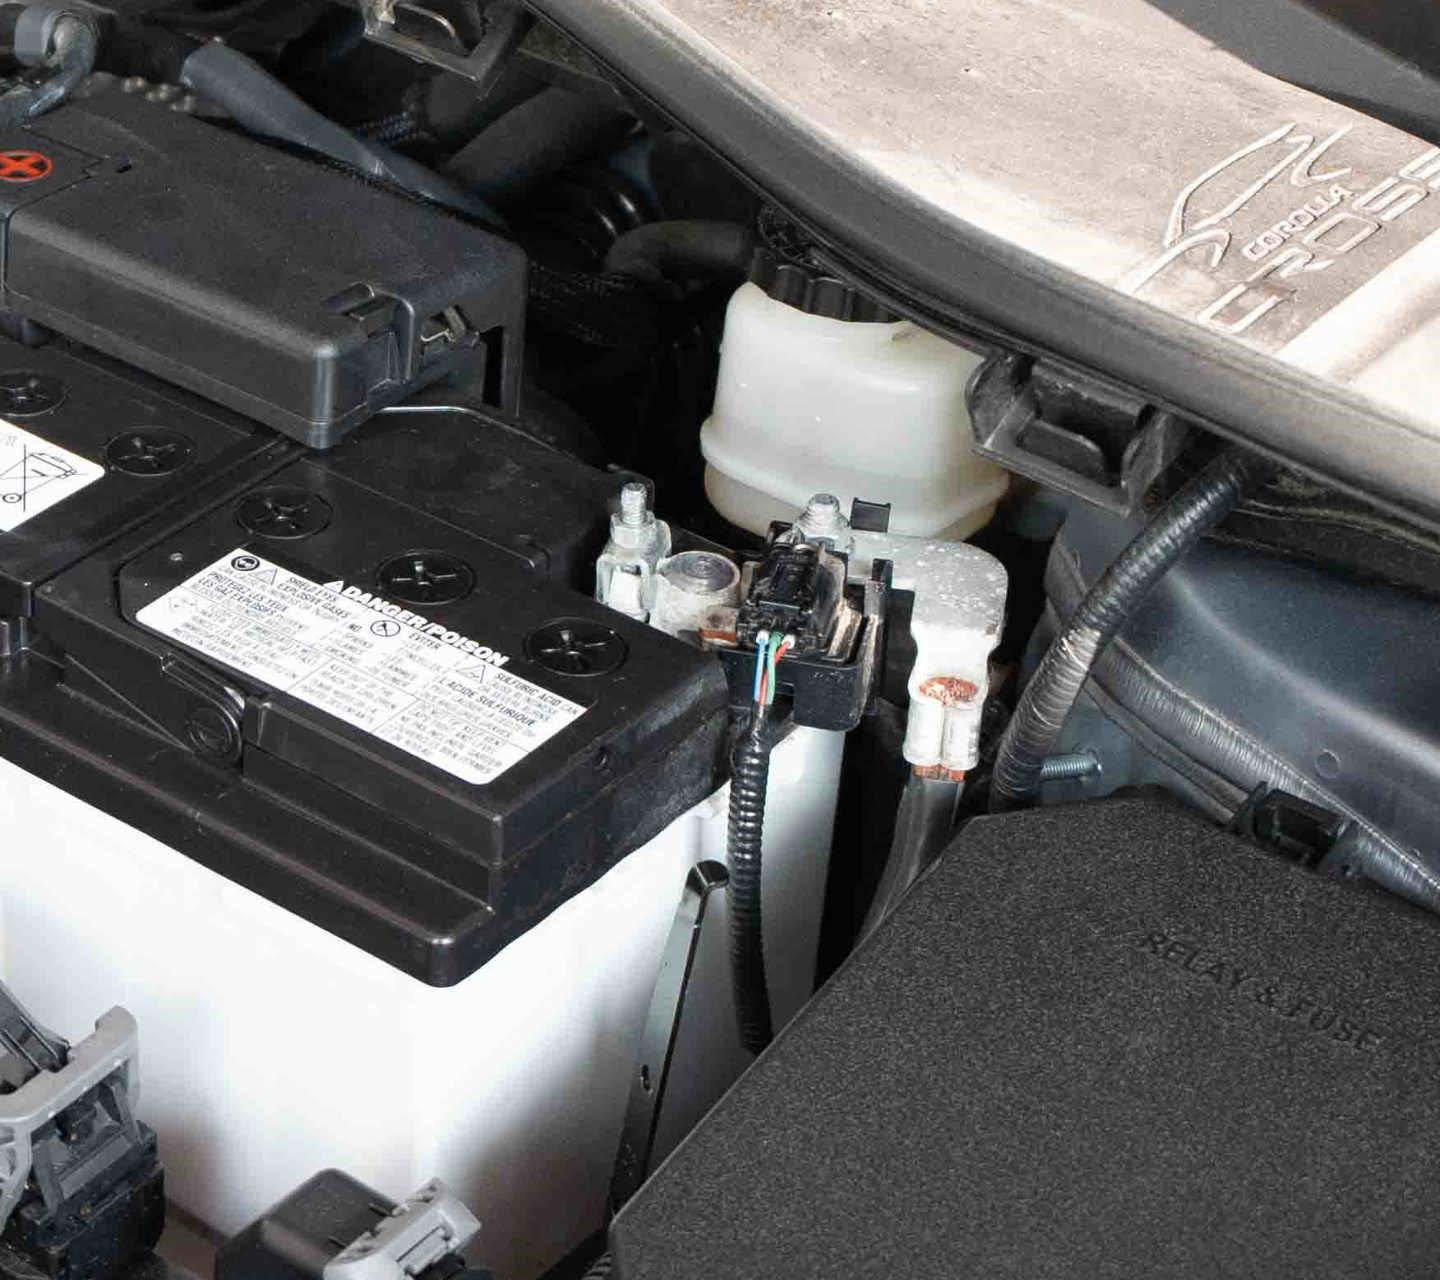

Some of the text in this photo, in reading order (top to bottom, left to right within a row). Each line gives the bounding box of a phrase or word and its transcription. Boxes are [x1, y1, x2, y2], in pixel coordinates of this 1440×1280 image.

[1241, 183, 1357, 261] COROLLA
[318, 601, 353, 619] GASES
[340, 584, 510, 667] DANGER/POISON
[473, 694, 539, 727] SULFURIQUE
[492, 671, 541, 696] SULFURIC
[535, 691, 564, 707] ACID
[1139, 931, 1255, 989] RELAY
[1287, 995, 1385, 1051] FUSE
